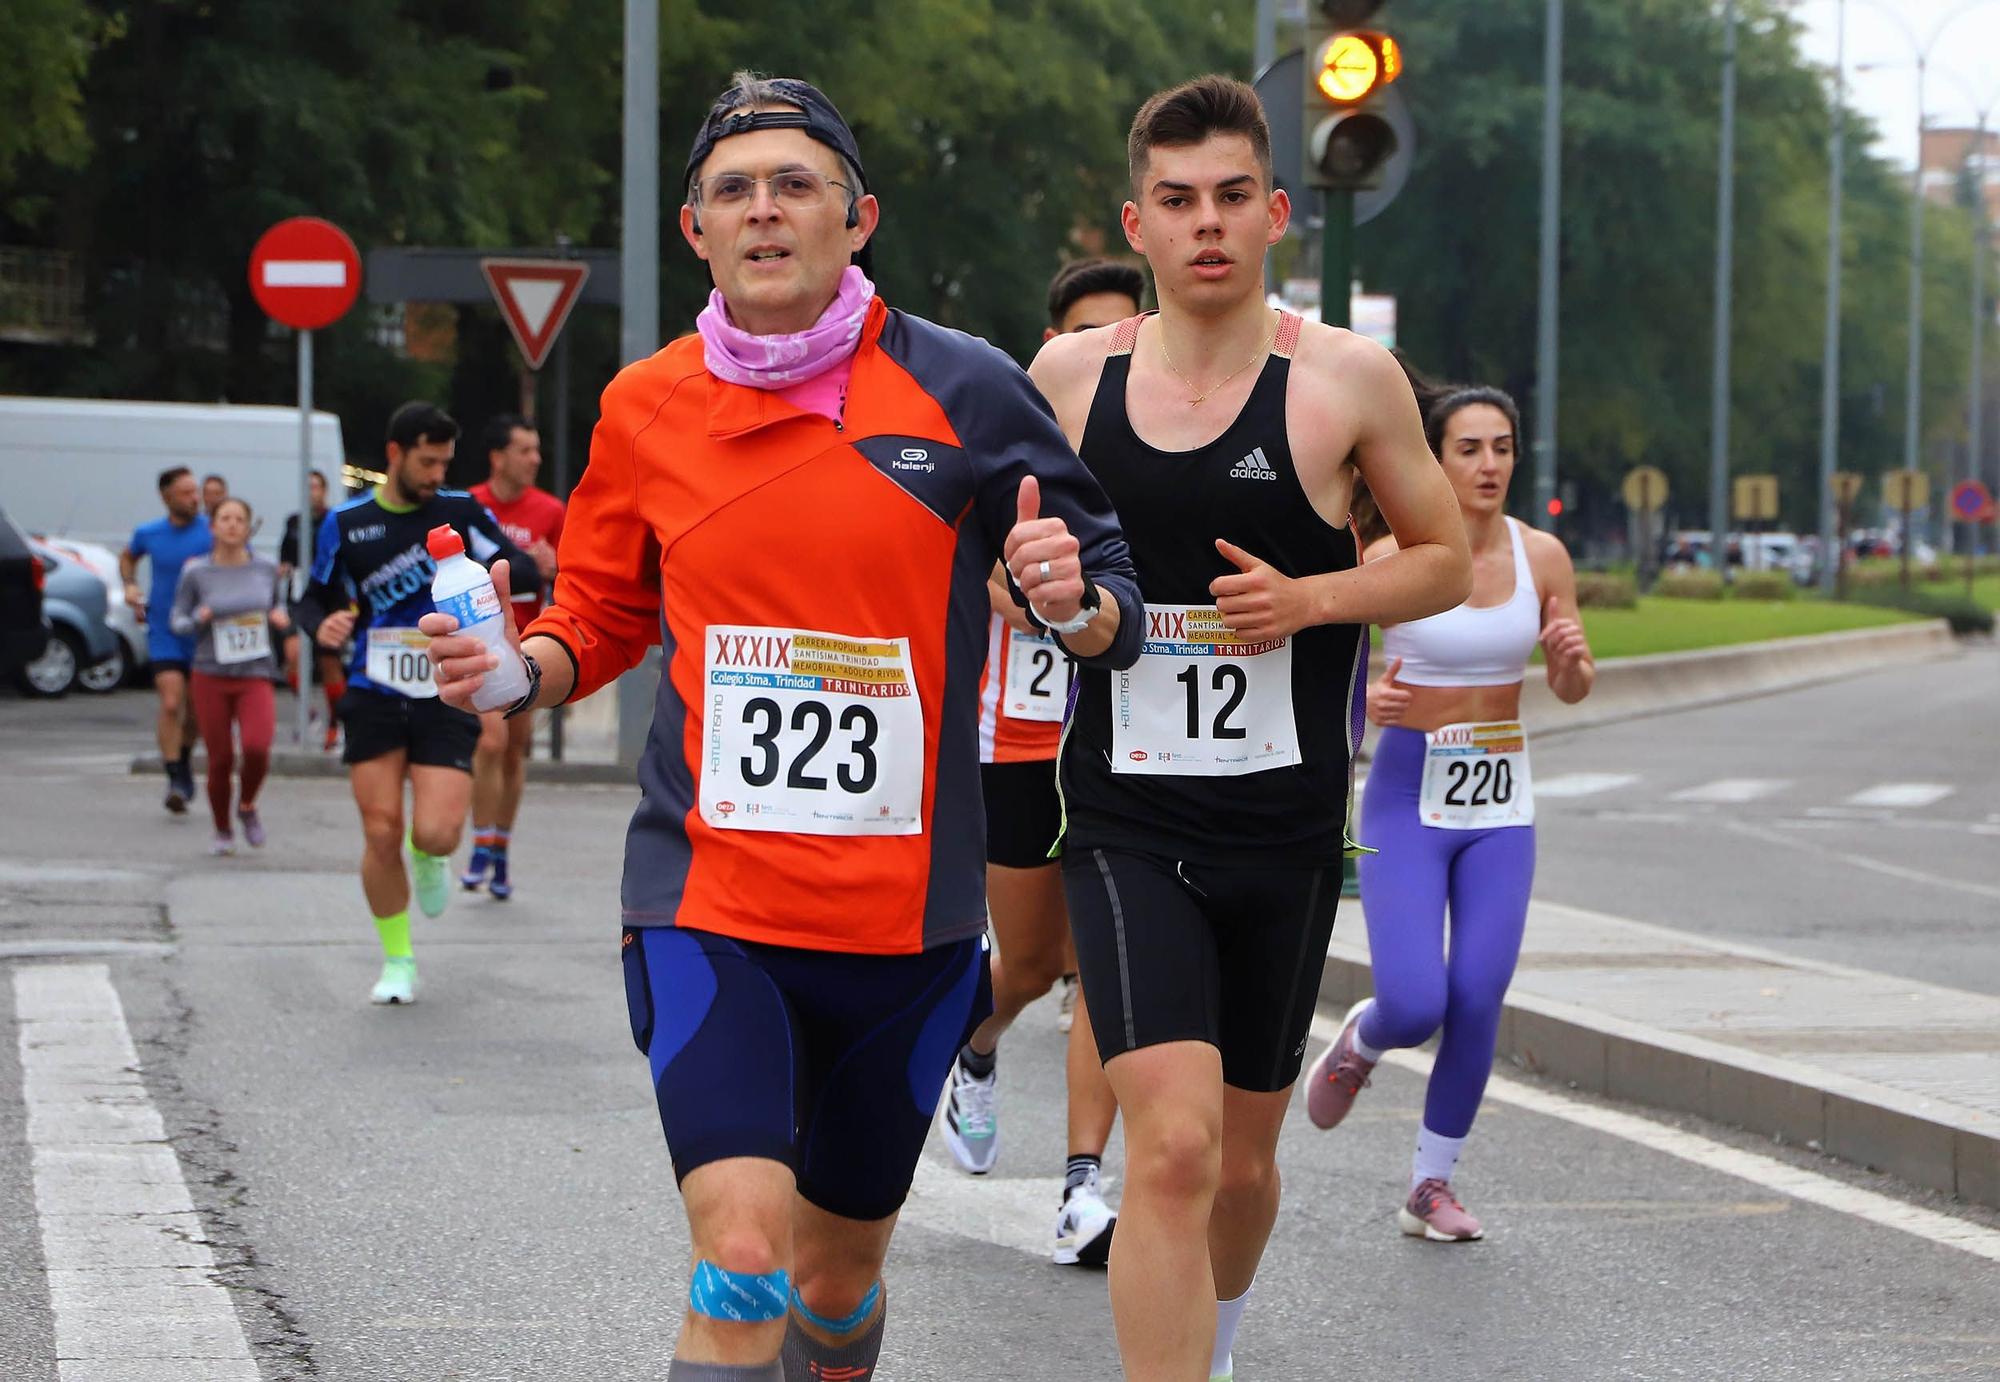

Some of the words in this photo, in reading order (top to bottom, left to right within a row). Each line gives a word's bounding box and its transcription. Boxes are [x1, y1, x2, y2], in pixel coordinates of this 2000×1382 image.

[892, 460, 935, 473] Kalenji
[1229, 466, 1277, 481] adidas
[1187, 611, 1222, 620] CARRERA
[1189, 631, 1226, 641] MEMORIAL
[715, 634, 791, 669] XXXIX
[794, 636, 832, 649] CARRERA
[833, 640, 868, 655] POPULAR
[1150, 645, 1172, 654] Stma.
[1174, 644, 1209, 655] Trinidad
[1218, 639, 1287, 655] TRINITARIOS
[389, 653, 429, 681] 100
[793, 661, 836, 674] MEMORIAL
[841, 653, 880, 667] TRINIDAD
[712, 672, 743, 686] Colegio
[745, 672, 772, 687] Stma.
[775, 674, 816, 690] Trinidad
[826, 679, 911, 697] TRINITARIOS
[1177, 663, 1248, 740] 12
[740, 697, 879, 794] 323
[1432, 728, 1473, 746] XXXIX
[1445, 758, 1512, 806] 220
